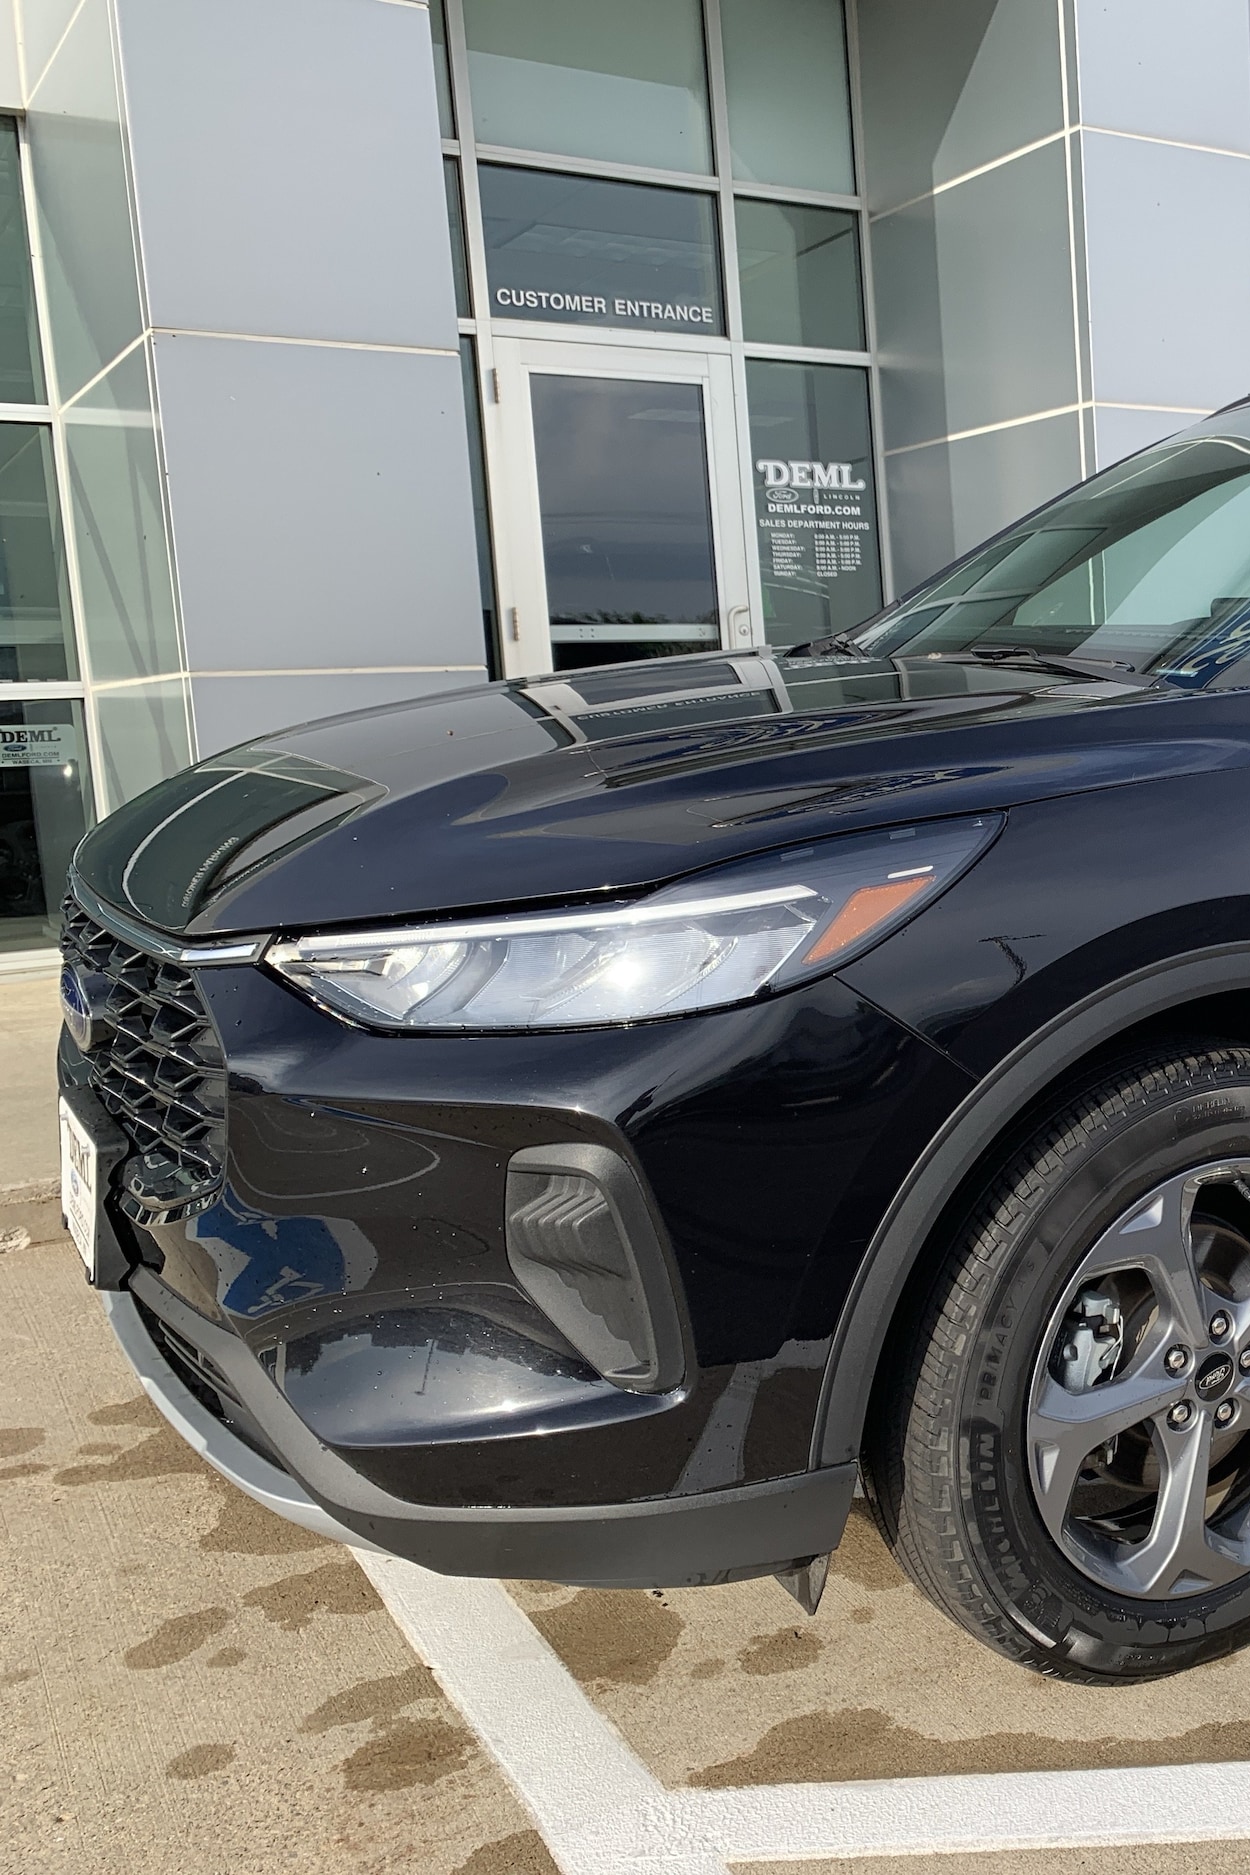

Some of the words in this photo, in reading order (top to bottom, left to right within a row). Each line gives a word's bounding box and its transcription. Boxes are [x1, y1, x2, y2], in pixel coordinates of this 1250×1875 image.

[496, 288, 606, 313] CUSTOMER
[614, 298, 714, 323] ENTRANCE
[756, 459, 866, 491] DEML
[767, 503, 861, 515] DEMLFORD.COM
[759, 519, 786, 528] SALES
[787, 519, 841, 530] DEPARTMENT
[842, 521, 870, 530] HOURS
[0, 729, 61, 743] DEML
[976, 1433, 1031, 1600] MICHELIN
